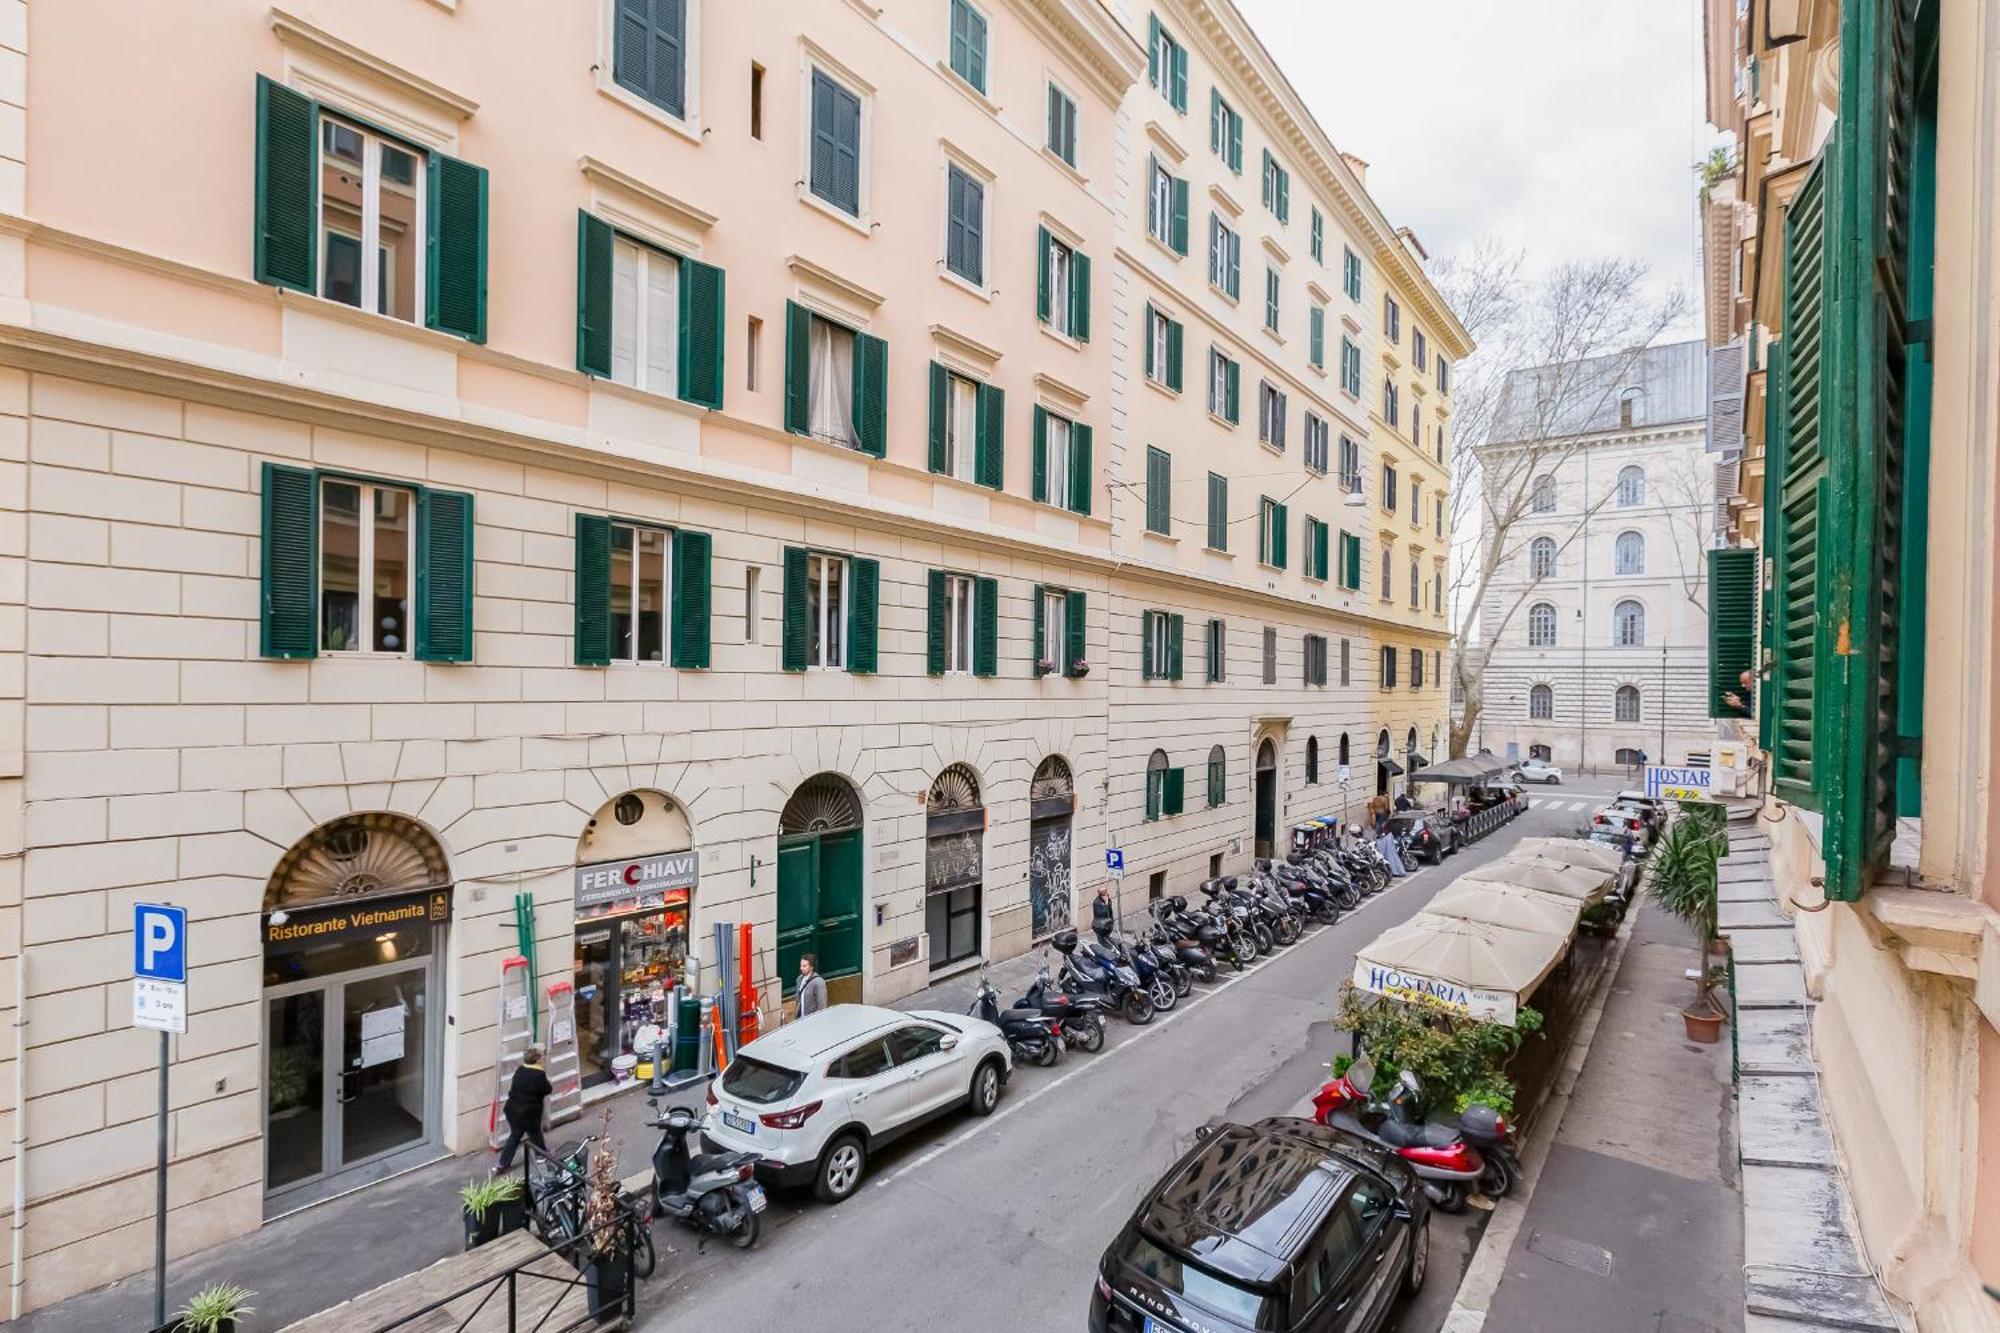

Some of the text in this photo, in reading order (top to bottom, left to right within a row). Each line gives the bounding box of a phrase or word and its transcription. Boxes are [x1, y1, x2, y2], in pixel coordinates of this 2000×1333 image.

[581, 857, 694, 891] FERCHIAVI
[1110, 852, 1119, 866] P
[143, 912, 176, 970] P
[269, 917, 347, 942] Ristorante
[351, 904, 425, 927] Vietnamita
[1369, 966, 1468, 1006] HOSTARIA
[1129, 1286, 1174, 1316] RANGE
